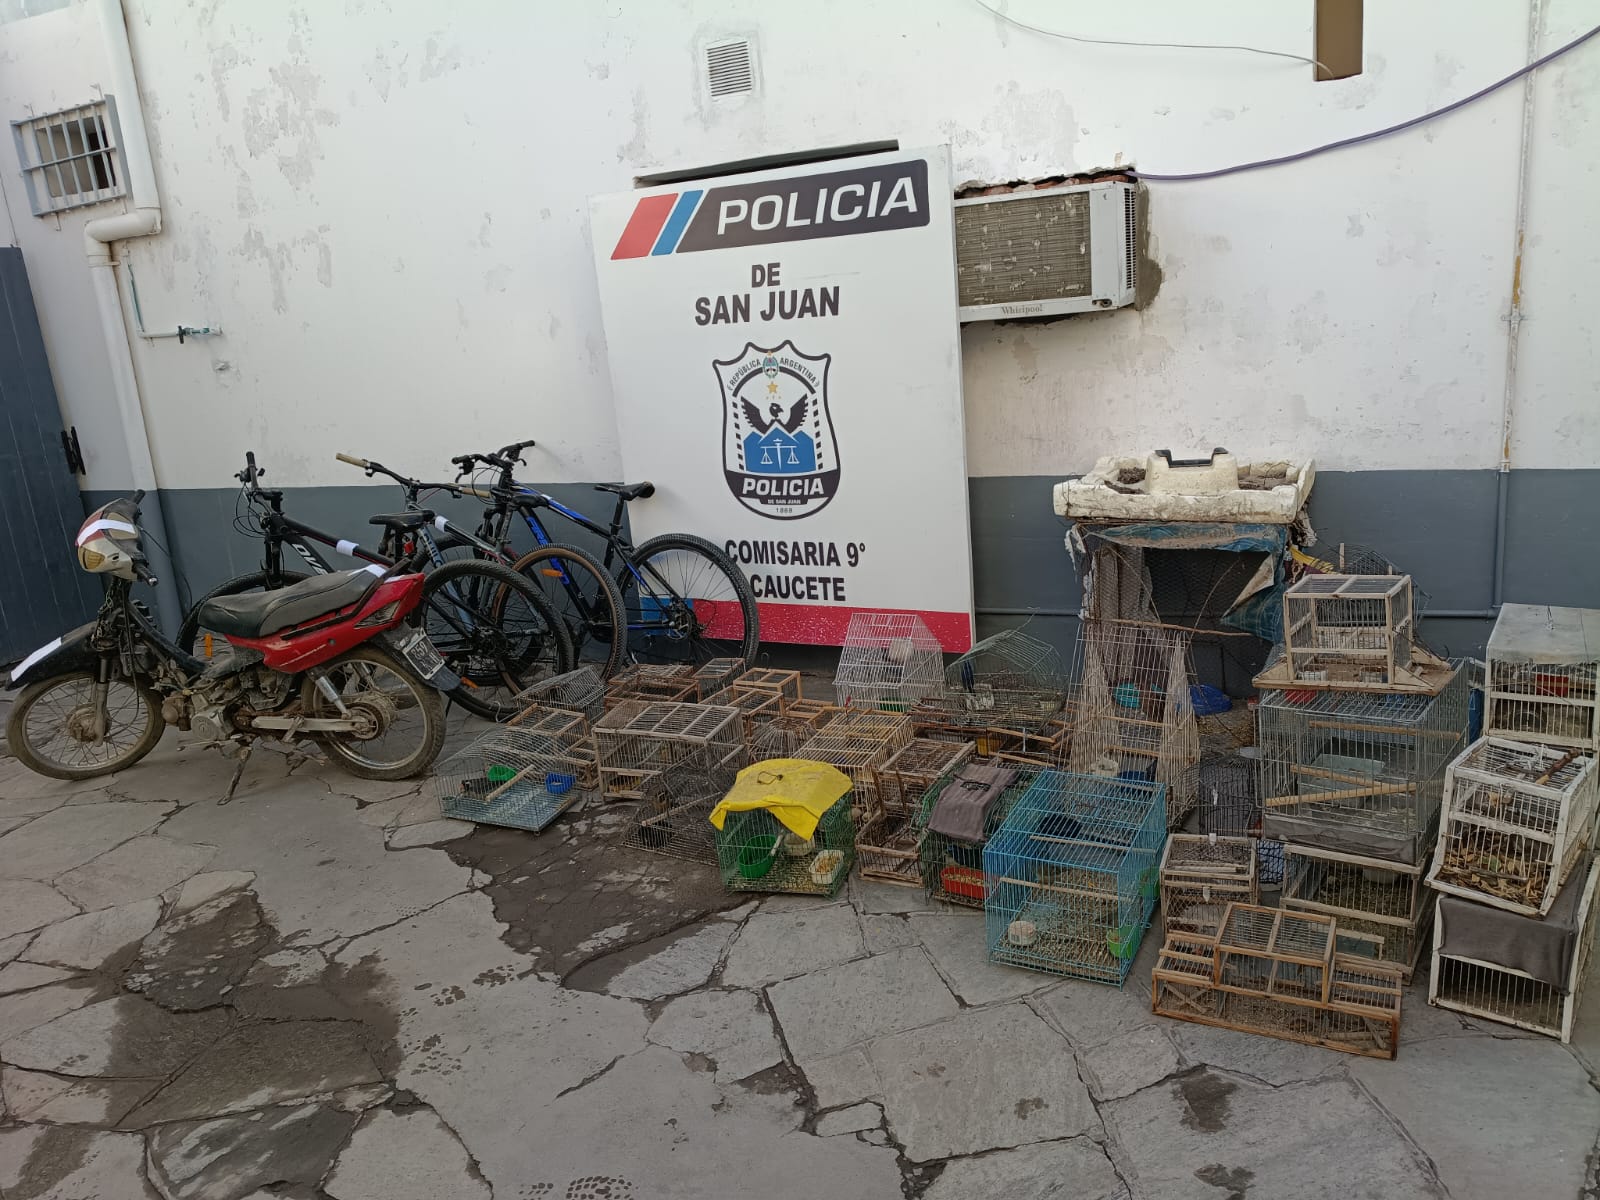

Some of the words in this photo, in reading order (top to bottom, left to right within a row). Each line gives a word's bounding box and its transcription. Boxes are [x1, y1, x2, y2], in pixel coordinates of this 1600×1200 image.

[717, 176, 918, 236] POLICIA
[751, 262, 781, 288] DE
[695, 293, 750, 326] SAN
[760, 286, 840, 321] JUAN
[729, 359, 761, 387] REPÚBLICA
[780, 357, 817, 384] ARGENTINA
[742, 477, 825, 496] POLICIA
[725, 540, 841, 567] COMISARIA
[750, 574, 846, 602] CAUCETE
